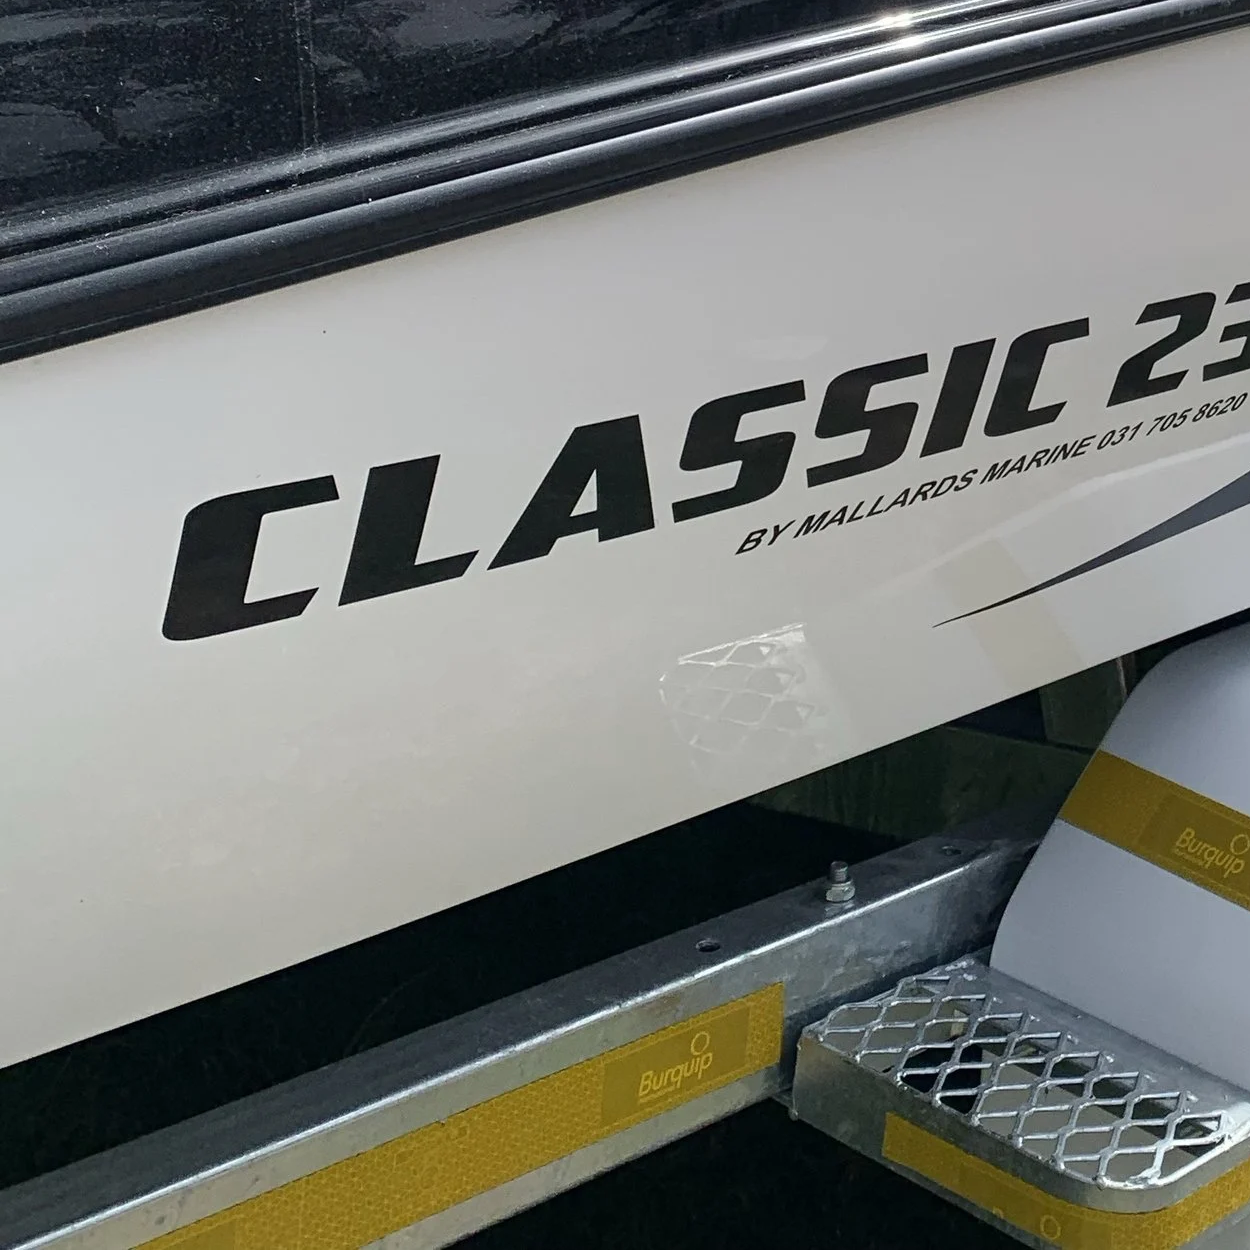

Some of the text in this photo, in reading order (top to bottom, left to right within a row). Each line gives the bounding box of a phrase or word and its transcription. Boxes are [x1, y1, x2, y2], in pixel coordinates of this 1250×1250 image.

[161, 316, 1090, 642] CLASSIC
[735, 392, 1249, 555] BY MALLARDS MARINE 031 705 8620
[1175, 827, 1250, 879] Burquip
[638, 1032, 713, 1097] Burquip
